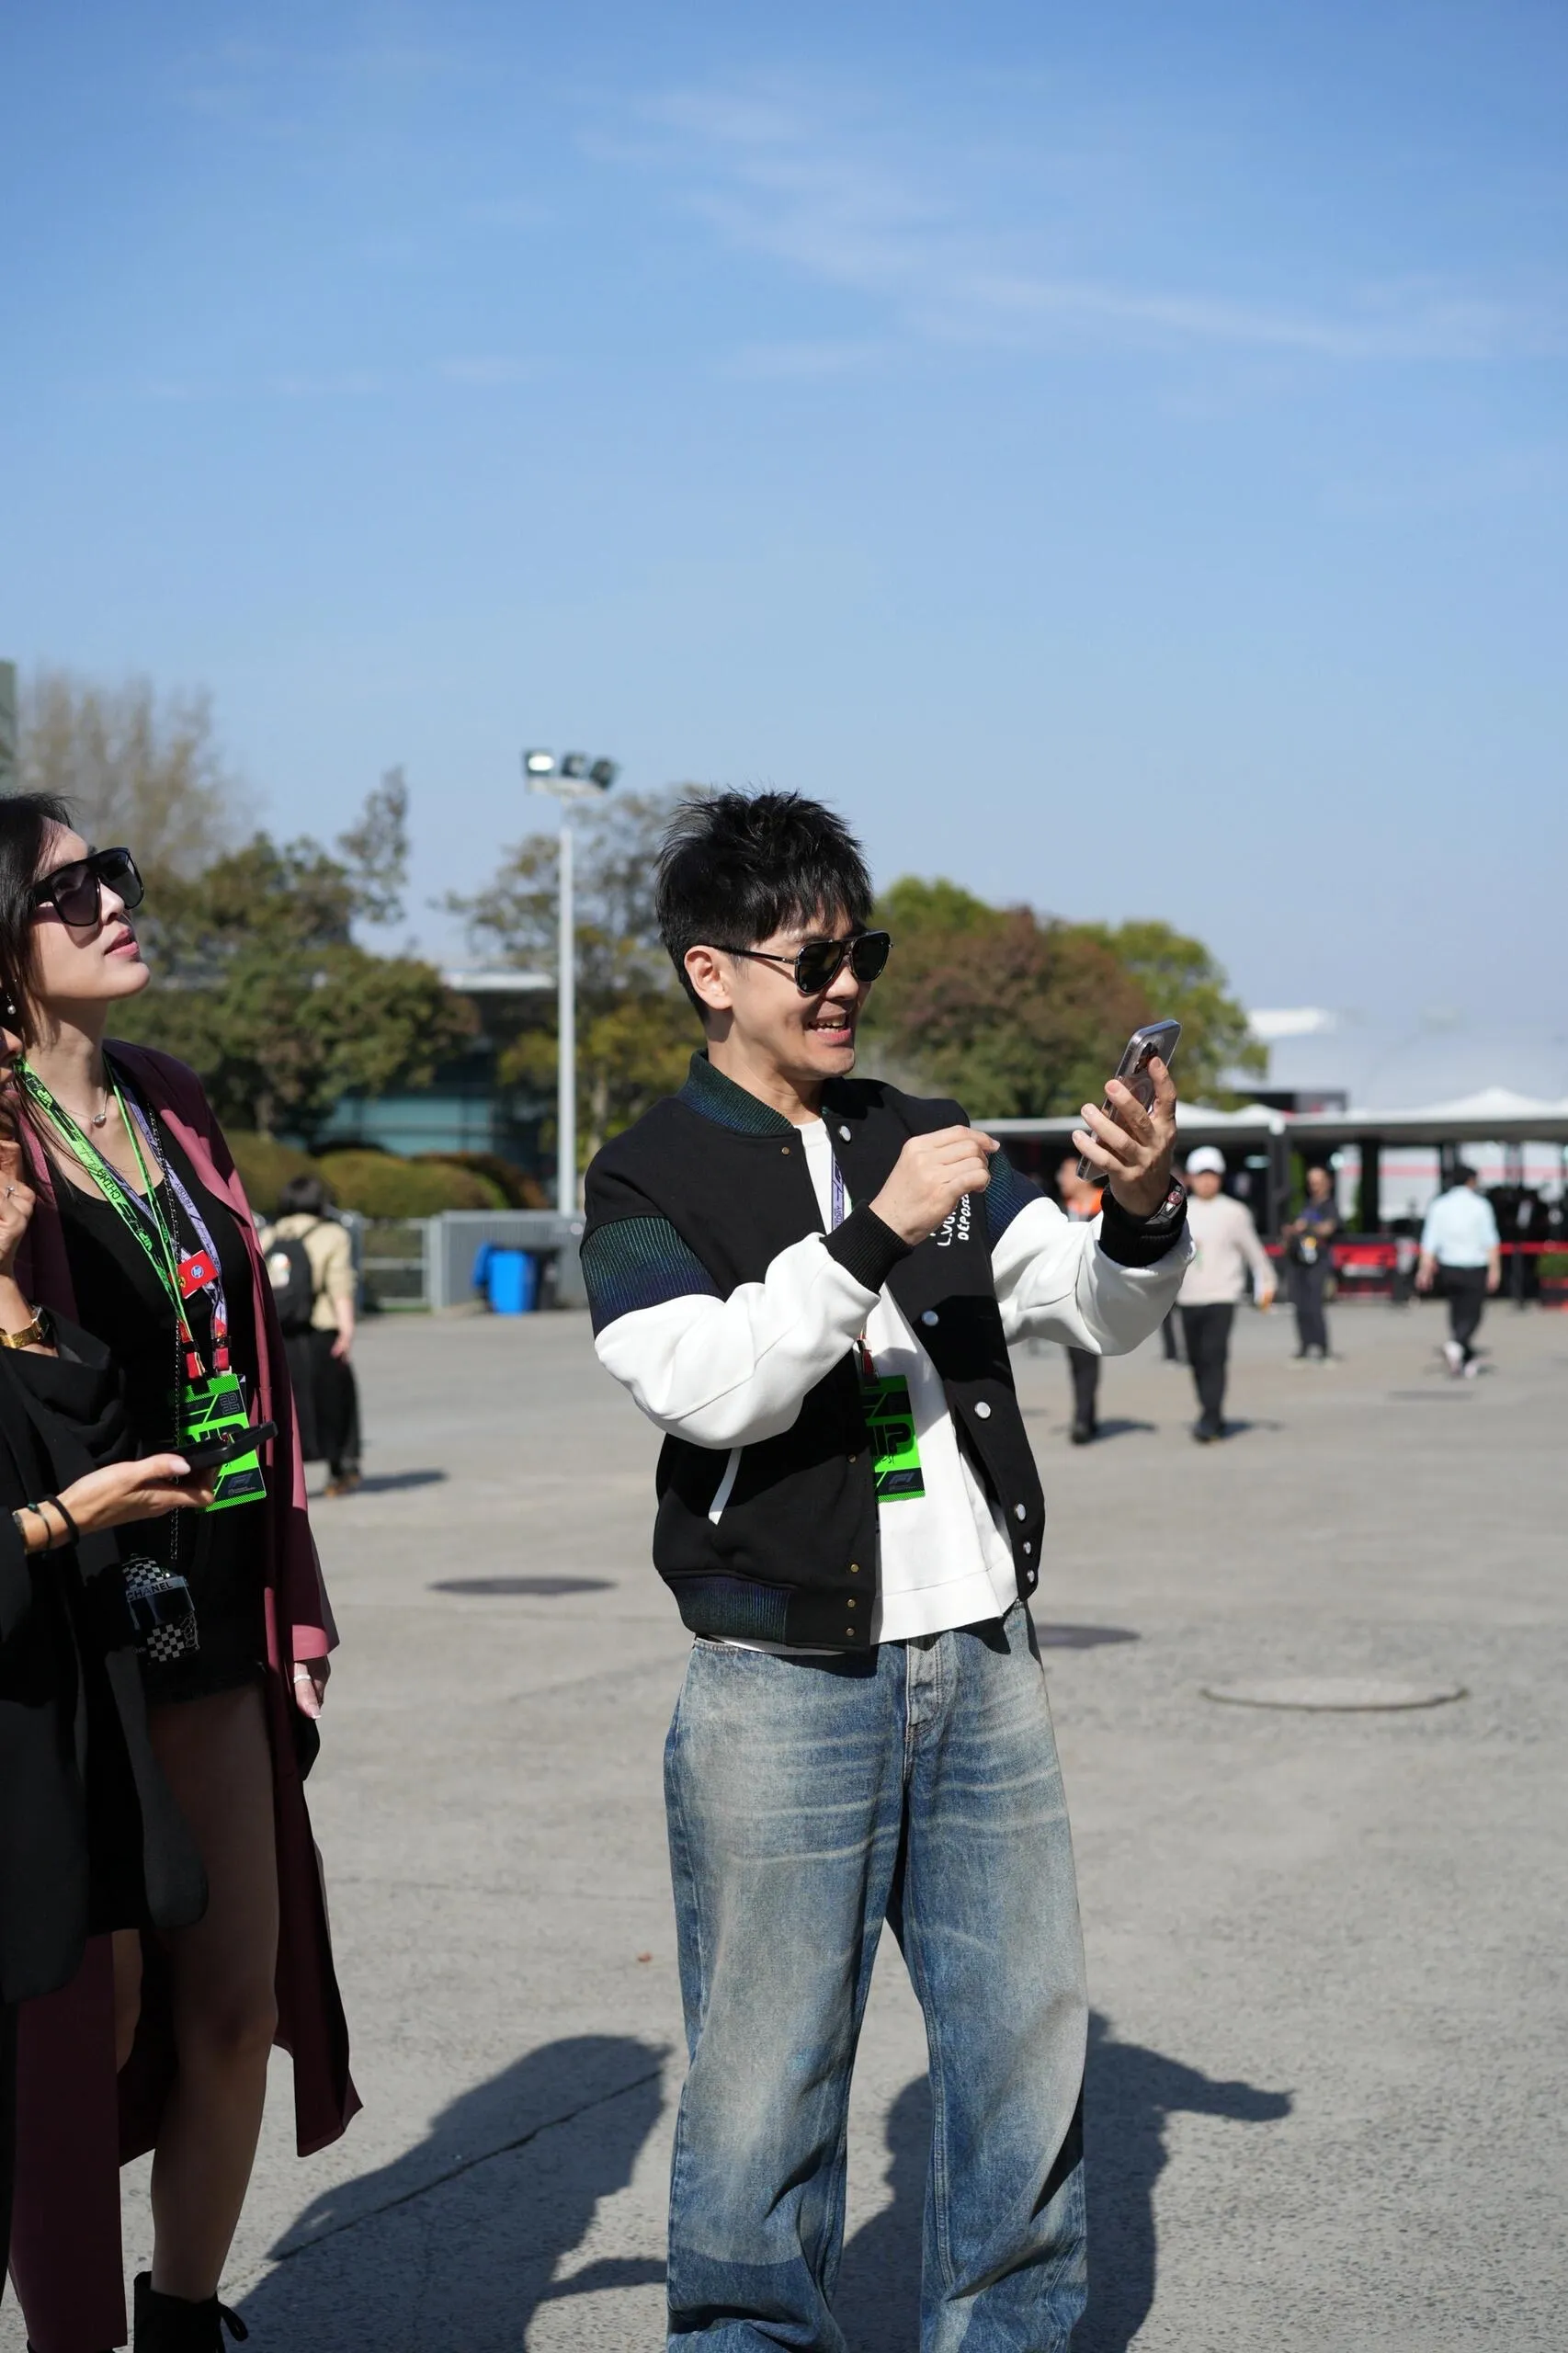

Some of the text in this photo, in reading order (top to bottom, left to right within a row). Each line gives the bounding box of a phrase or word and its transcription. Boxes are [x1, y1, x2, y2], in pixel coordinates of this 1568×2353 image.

[97, 1168, 121, 1199] CHINA
[175, 1182, 194, 1209] FRIDAY
[127, 1581, 174, 1600] CHANEL
